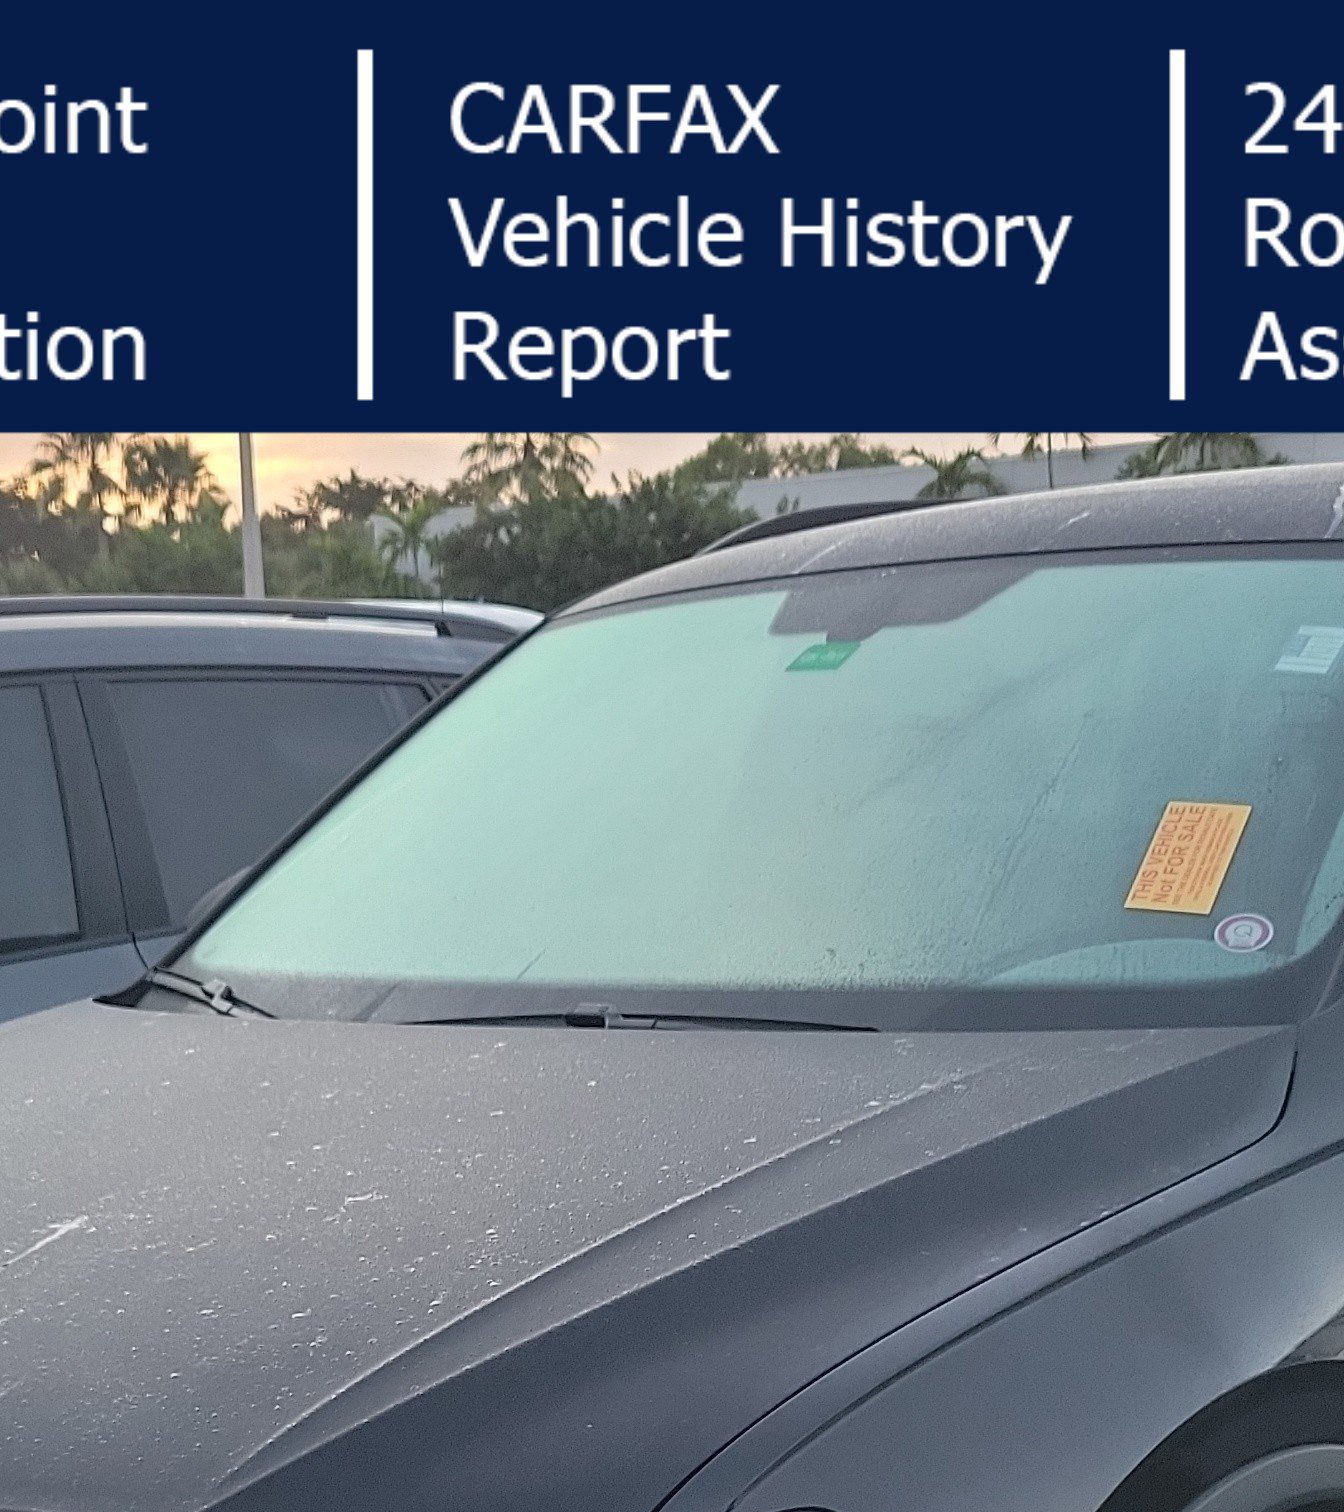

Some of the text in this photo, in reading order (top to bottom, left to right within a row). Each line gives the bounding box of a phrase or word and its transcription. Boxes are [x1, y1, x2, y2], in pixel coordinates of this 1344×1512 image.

[1131, 806, 1186, 900] THIS VEHICLE
[1164, 847, 1189, 875] FOR
[1178, 806, 1205, 841] SALE
